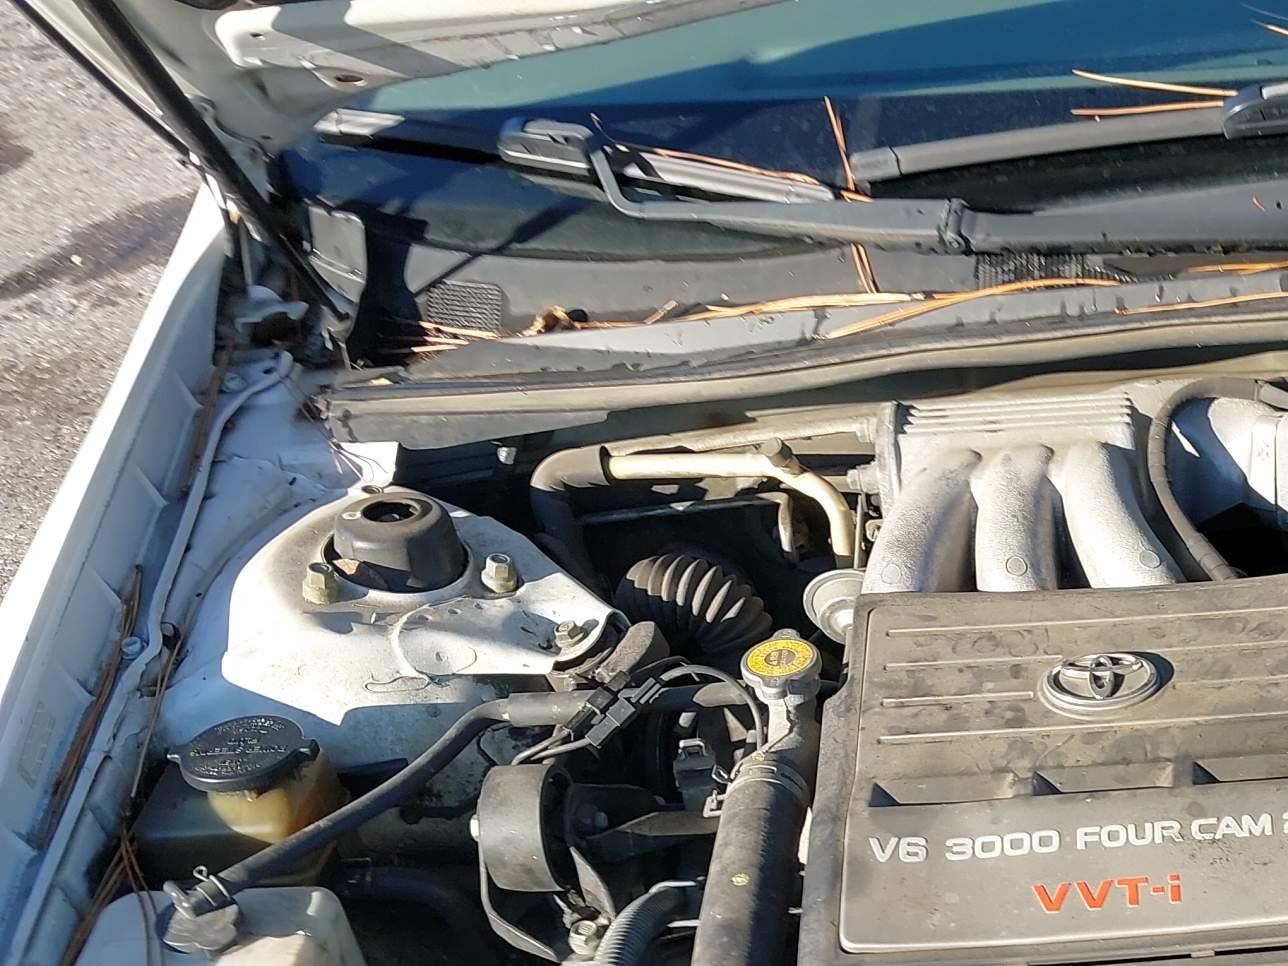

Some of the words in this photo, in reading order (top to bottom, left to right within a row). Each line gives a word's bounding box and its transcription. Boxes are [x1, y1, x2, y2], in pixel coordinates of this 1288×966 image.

[868, 836, 928, 863] V6
[945, 830, 1060, 862] 3000
[1076, 820, 1184, 851] FOUR
[1191, 812, 1273, 841] CAM
[1032, 873, 1183, 914] VVT-i
